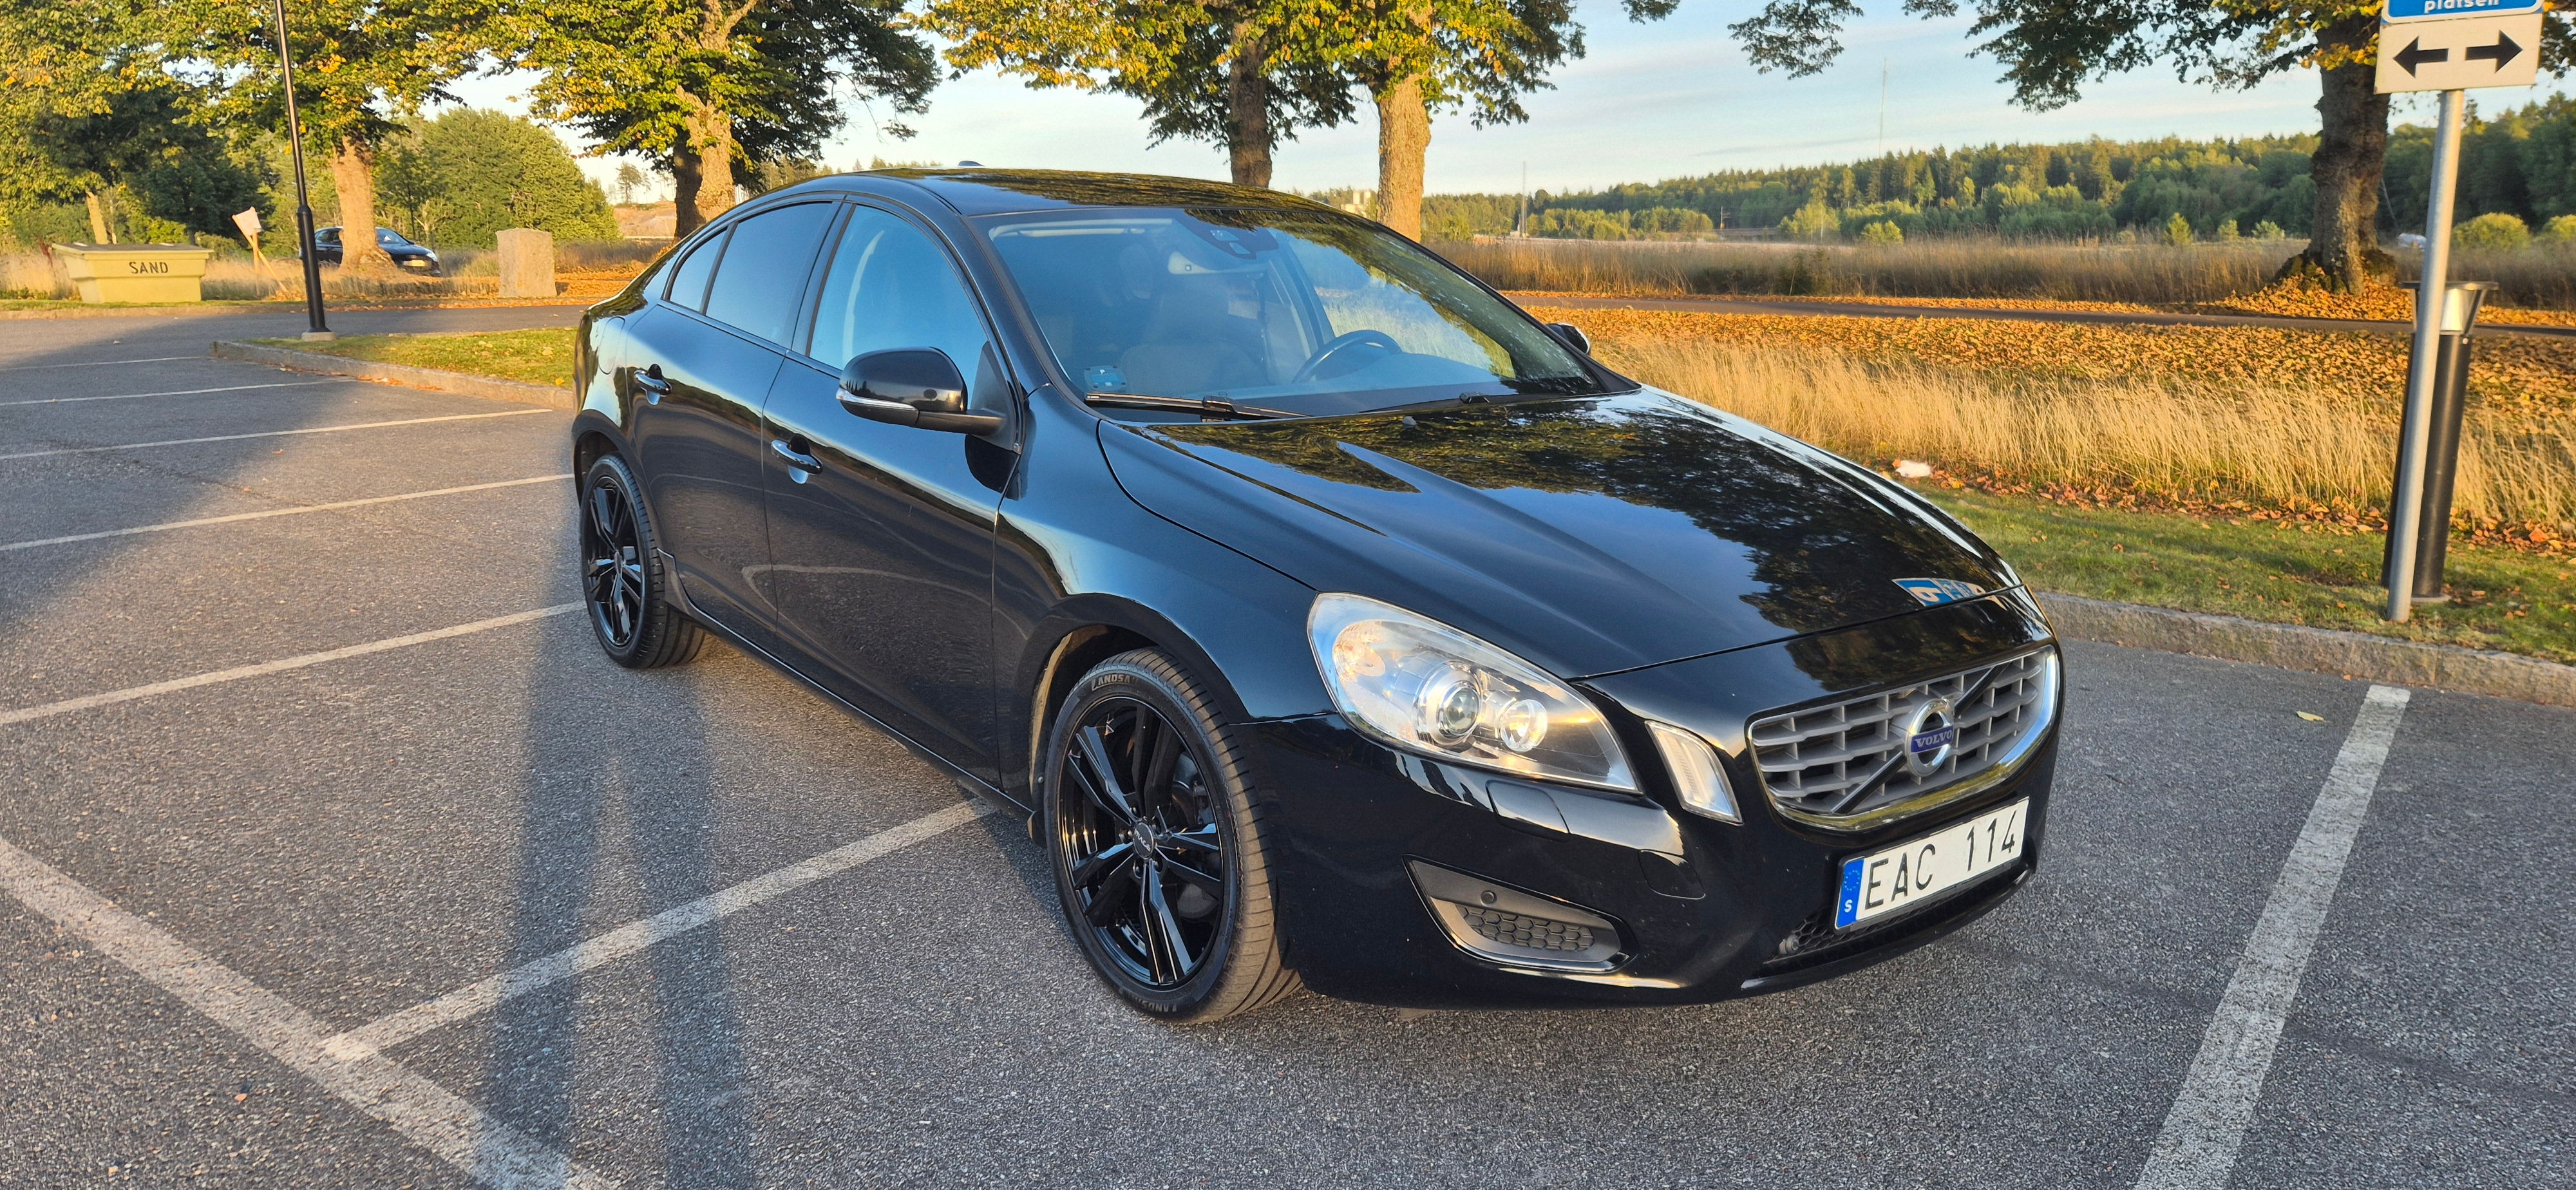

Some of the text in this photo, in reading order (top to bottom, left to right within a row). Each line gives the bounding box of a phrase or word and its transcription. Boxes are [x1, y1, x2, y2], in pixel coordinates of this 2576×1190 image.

[129, 261, 168, 274] SAND
[1915, 730, 1953, 748] VOLVO
[1865, 810, 2017, 910] EAC 114
[1844, 899, 1852, 913] S
